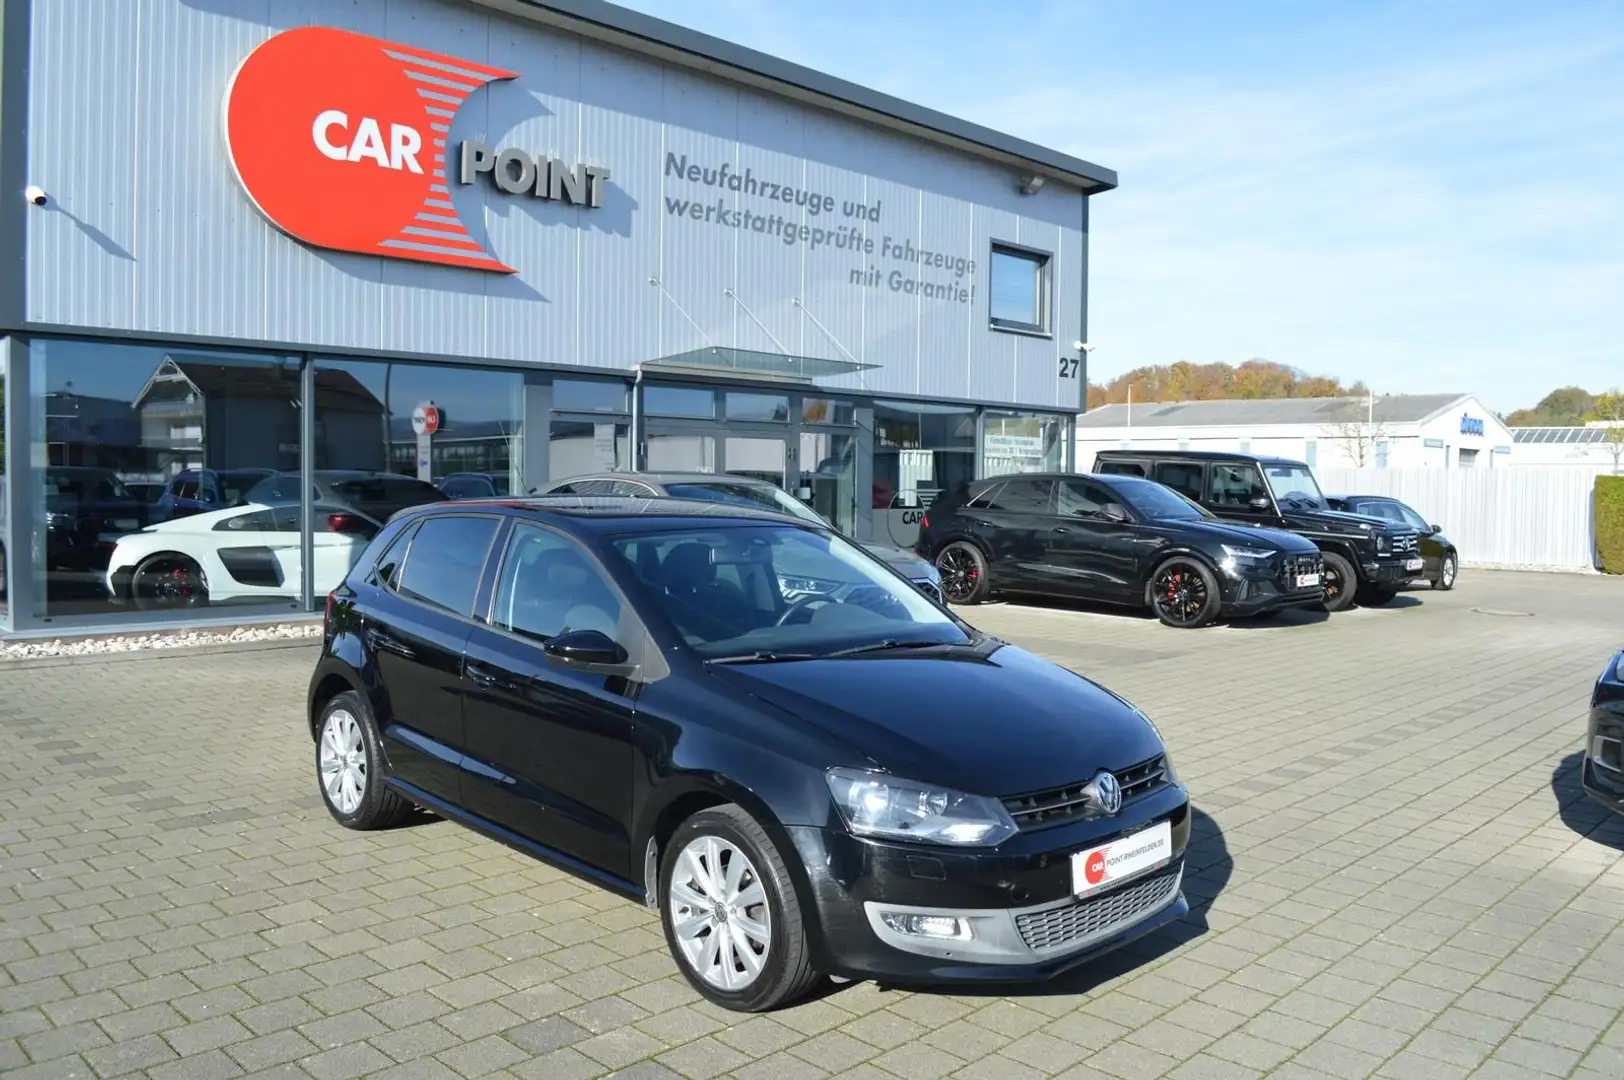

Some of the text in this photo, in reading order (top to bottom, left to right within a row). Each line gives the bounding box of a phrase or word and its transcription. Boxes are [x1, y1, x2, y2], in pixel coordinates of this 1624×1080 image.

[312, 110, 610, 208] CAR POINT
[664, 152, 882, 223] Neufahrzeuge und
[664, 196, 977, 277] werkstattgeprüfte Fahrzeuge
[849, 265, 976, 305] mit Garantie!
[1059, 357, 1079, 379] 27
[1091, 860, 1105, 873] CAR
